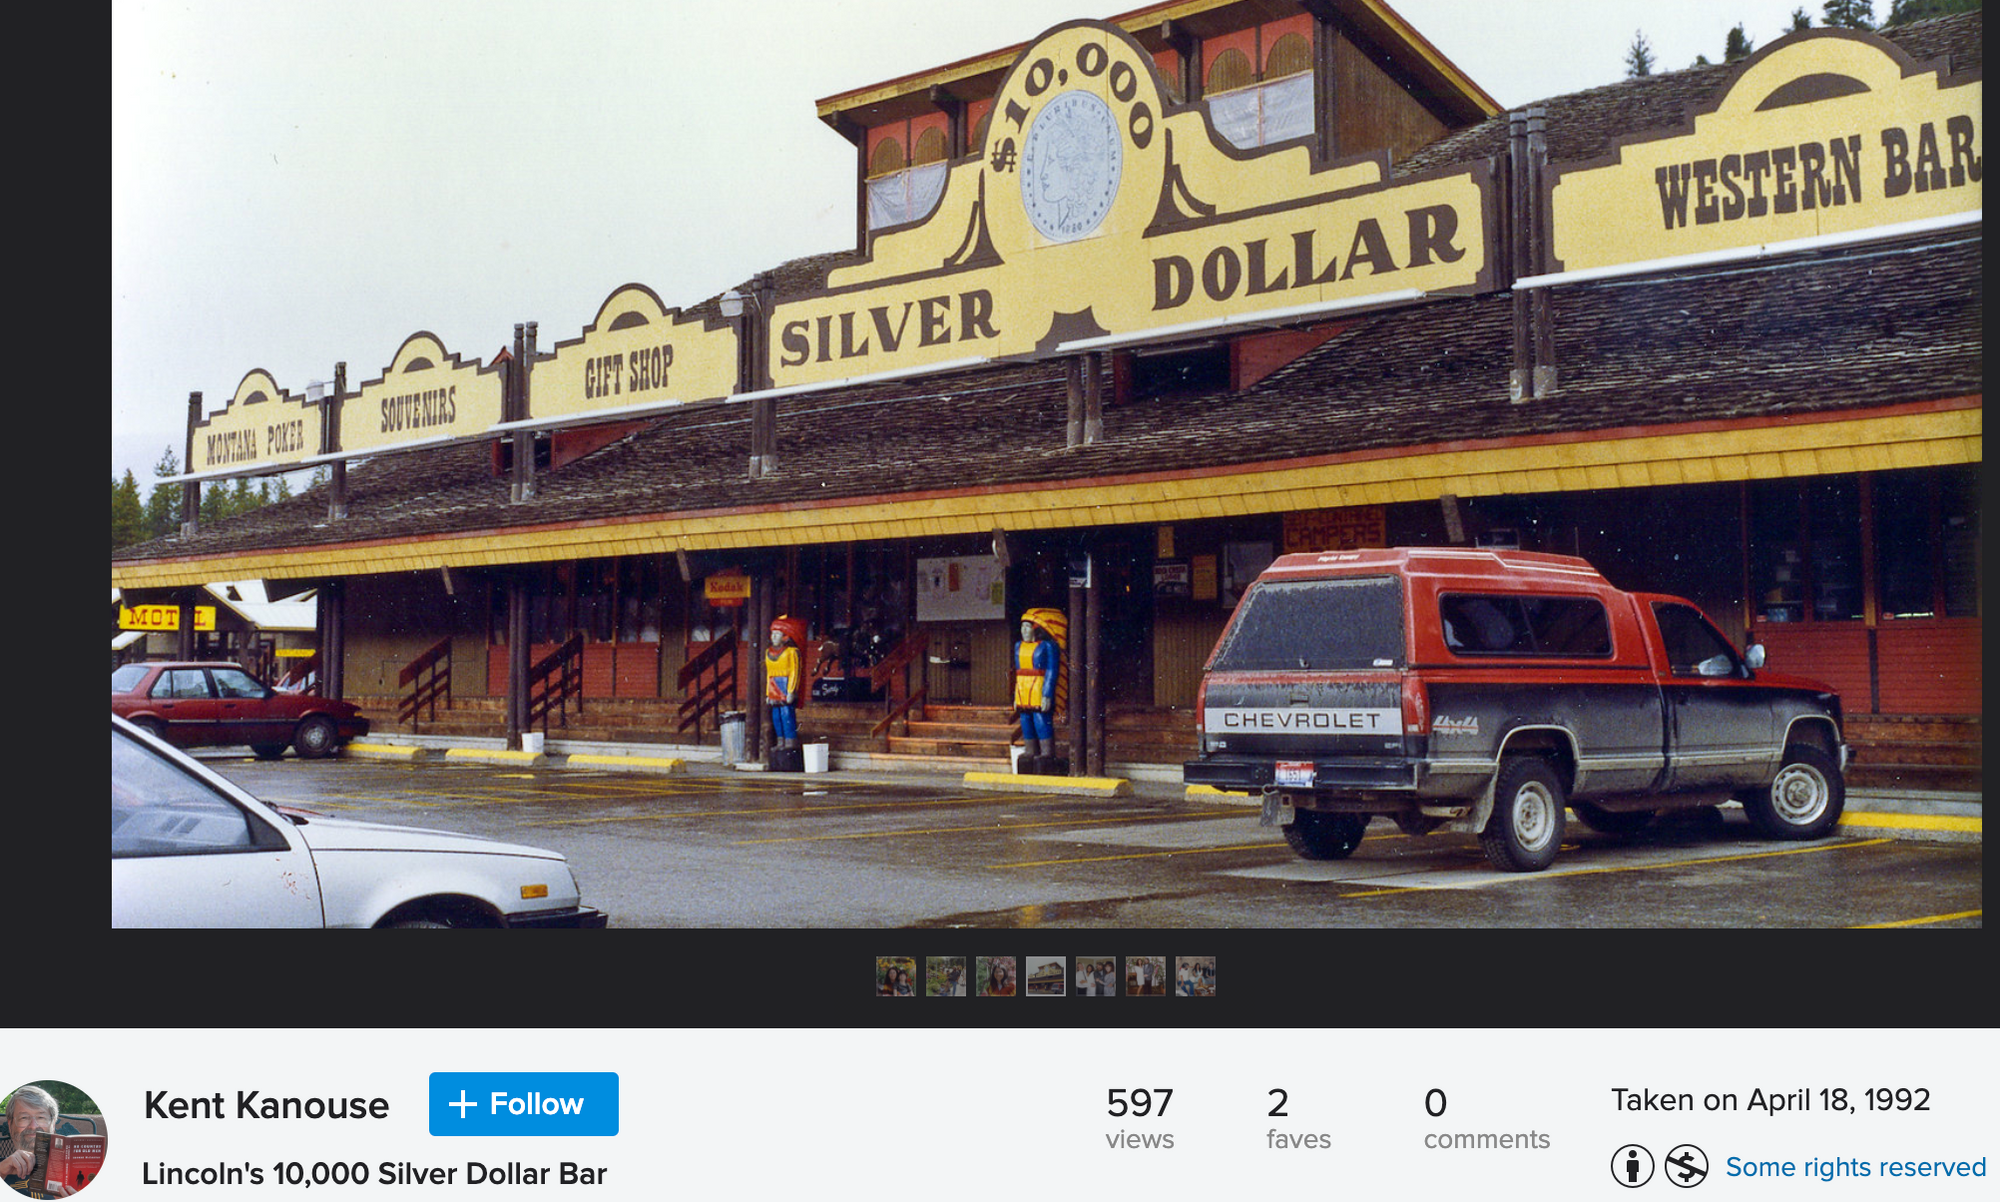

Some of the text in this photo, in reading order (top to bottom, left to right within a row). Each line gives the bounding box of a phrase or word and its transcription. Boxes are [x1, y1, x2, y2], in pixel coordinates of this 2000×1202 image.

[990, 42, 1154, 174] $10,000
[1655, 114, 1981, 230] WESTERN BAR
[781, 203, 1466, 368] SILVER DOLLAR
[585, 344, 673, 399] GIFT SHOP
[381, 386, 457, 434] SOUVENIRS
[207, 418, 304, 465] MONTANA POKER
[1286, 523, 1381, 546] CAMPERS
[710, 581, 744, 593] Kodak
[129, 608, 206, 627] MOTL
[1224, 713, 1381, 728] CHEVROLET
